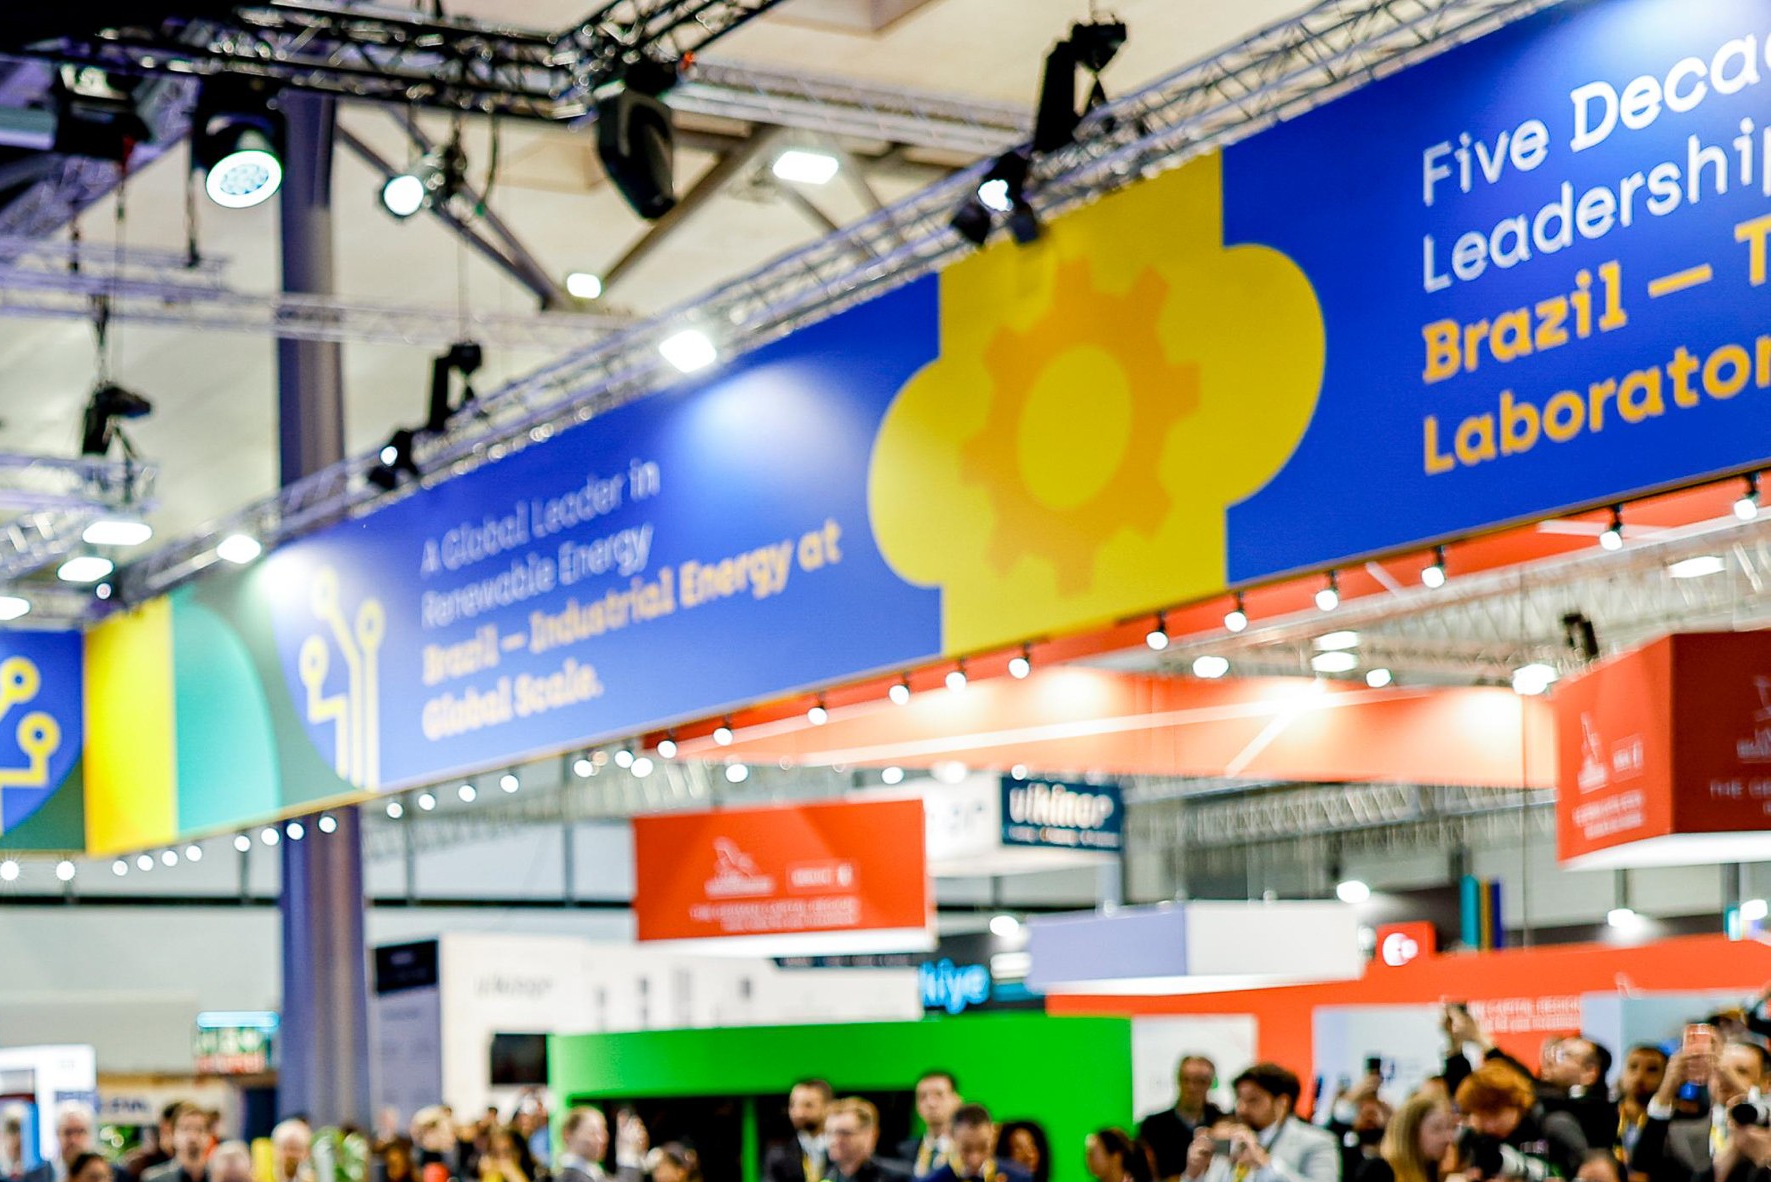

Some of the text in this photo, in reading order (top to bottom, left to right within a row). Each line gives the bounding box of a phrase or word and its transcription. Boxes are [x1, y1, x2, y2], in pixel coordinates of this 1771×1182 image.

[1422, 33, 1771, 206] Five Deca
[1422, 260, 1627, 384] Brazil
[442, 500, 529, 571] Global
[532, 472, 625, 539] Leader
[629, 458, 661, 501] in
[422, 523, 654, 629] Renewable Energy
[422, 623, 500, 687] Brazil
[529, 566, 675, 654] Industrial
[679, 540, 794, 609] Energy
[798, 517, 843, 572] at
[422, 657, 604, 741] Global Scale.
